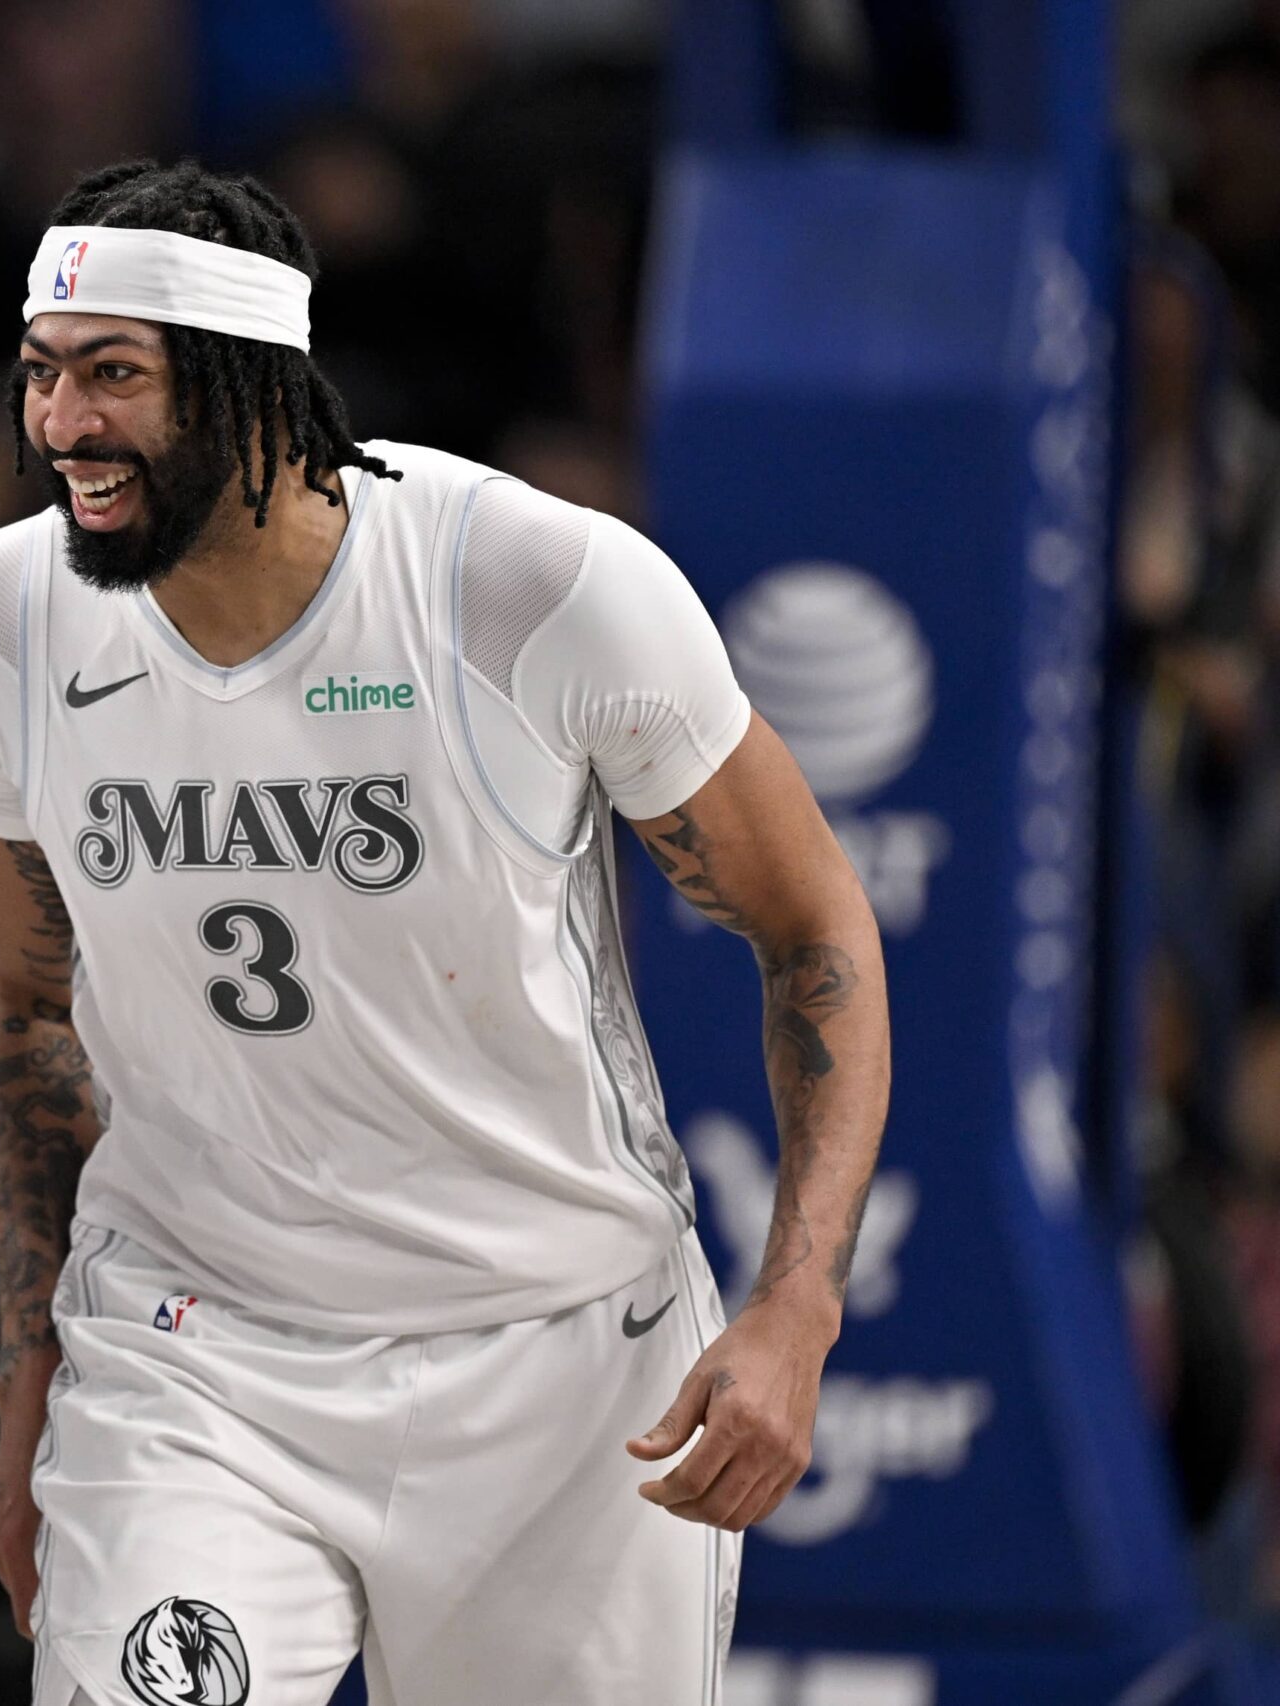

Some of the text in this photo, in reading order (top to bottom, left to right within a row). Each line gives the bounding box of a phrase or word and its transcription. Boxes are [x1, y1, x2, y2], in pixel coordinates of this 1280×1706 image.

[305, 676, 415, 713] chime
[75, 774, 425, 896] MAVS
[198, 899, 315, 1037] 3
